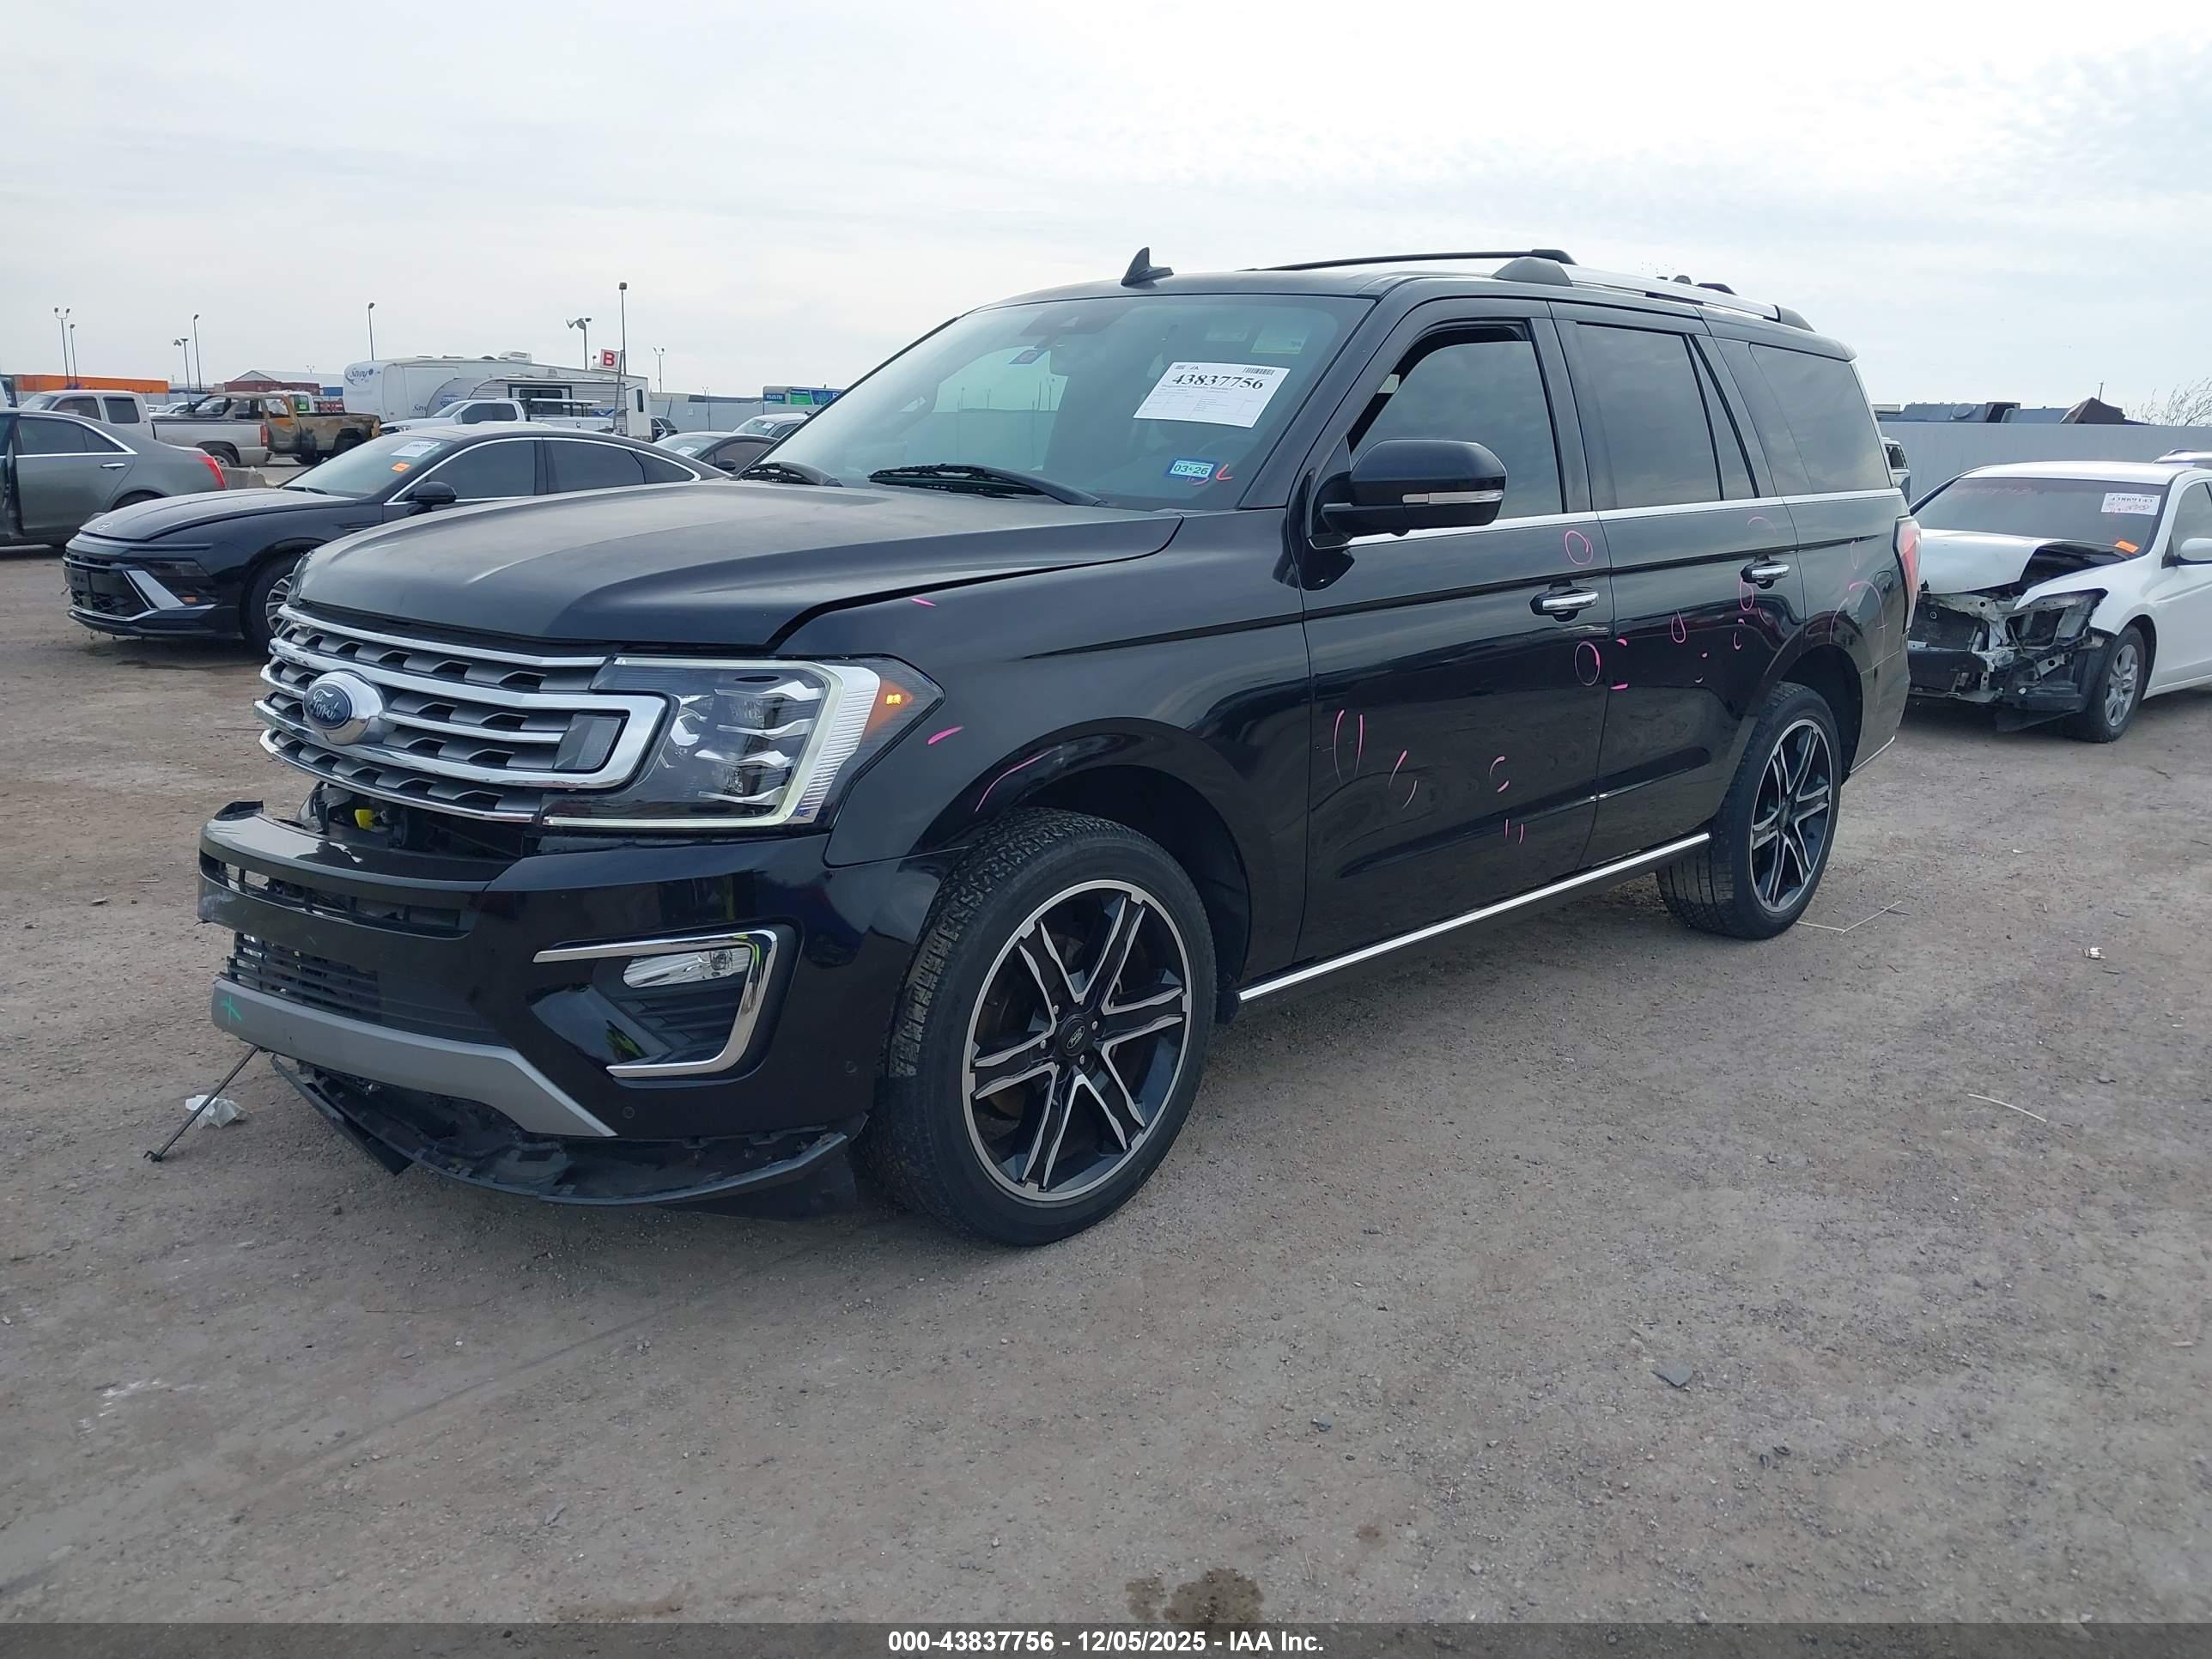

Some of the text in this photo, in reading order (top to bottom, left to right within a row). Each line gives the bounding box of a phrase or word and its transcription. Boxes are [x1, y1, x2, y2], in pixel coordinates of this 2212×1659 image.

[603, 351, 615, 367] B
[1172, 374, 1266, 390] 43837756
[1173, 465, 1209, 475] 03 26
[308, 689, 339, 721] Ford
